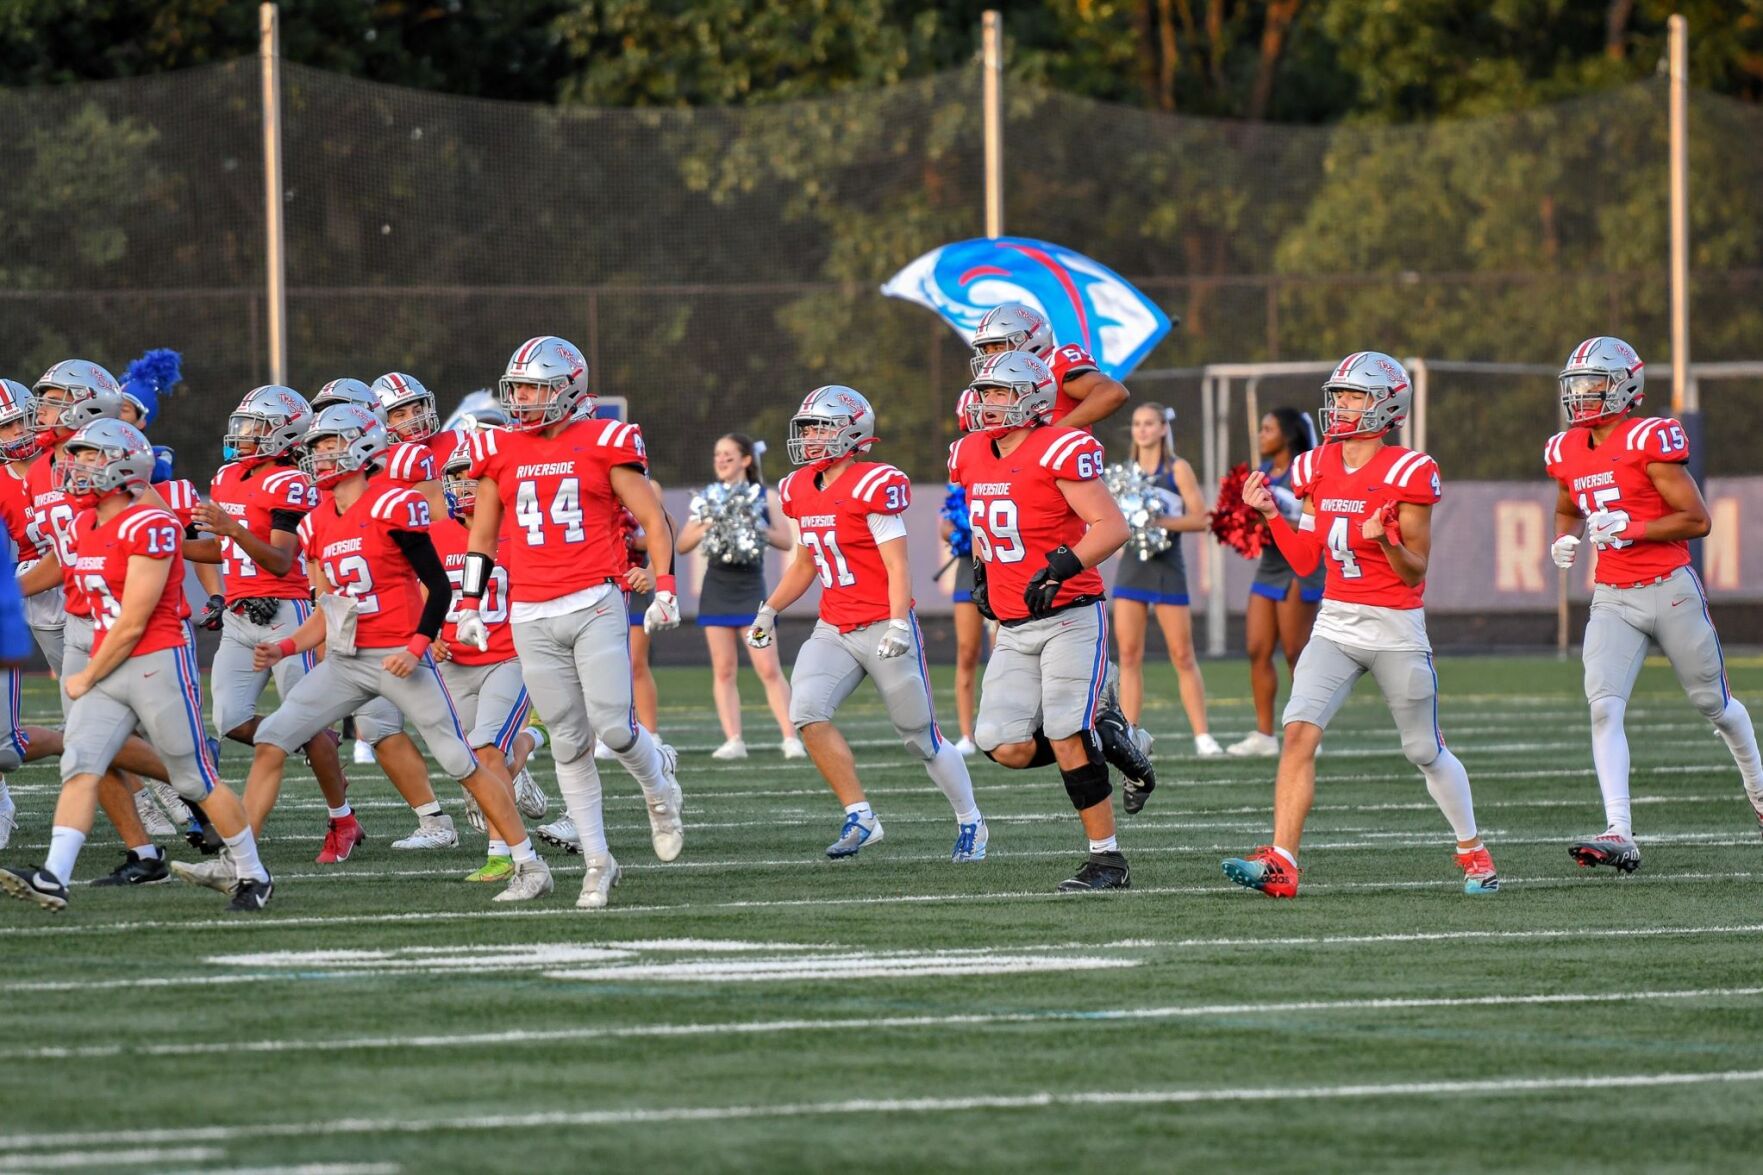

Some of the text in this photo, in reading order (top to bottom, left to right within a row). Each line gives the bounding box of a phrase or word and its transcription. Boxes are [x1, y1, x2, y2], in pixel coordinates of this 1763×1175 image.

[1656, 426, 1685, 454] 15
[516, 461, 575, 478] RIVERSIDE
[1077, 452, 1104, 479] 69
[286, 482, 319, 507] 24
[972, 482, 1012, 497] RIVERSIDE
[1430, 471, 1441, 496] 4
[1574, 470, 1616, 492] RIVERSIDE
[885, 484, 909, 510] 31
[1320, 498, 1367, 514] RIVERSIDE
[407, 500, 431, 528] 12
[515, 477, 585, 546] 44
[801, 514, 837, 529] RIVERSIDE
[147, 525, 177, 555] 13
[968, 499, 1026, 564] 69
[801, 529, 857, 590] 31
[1327, 516, 1363, 579] 4
[323, 554, 382, 616] 12
